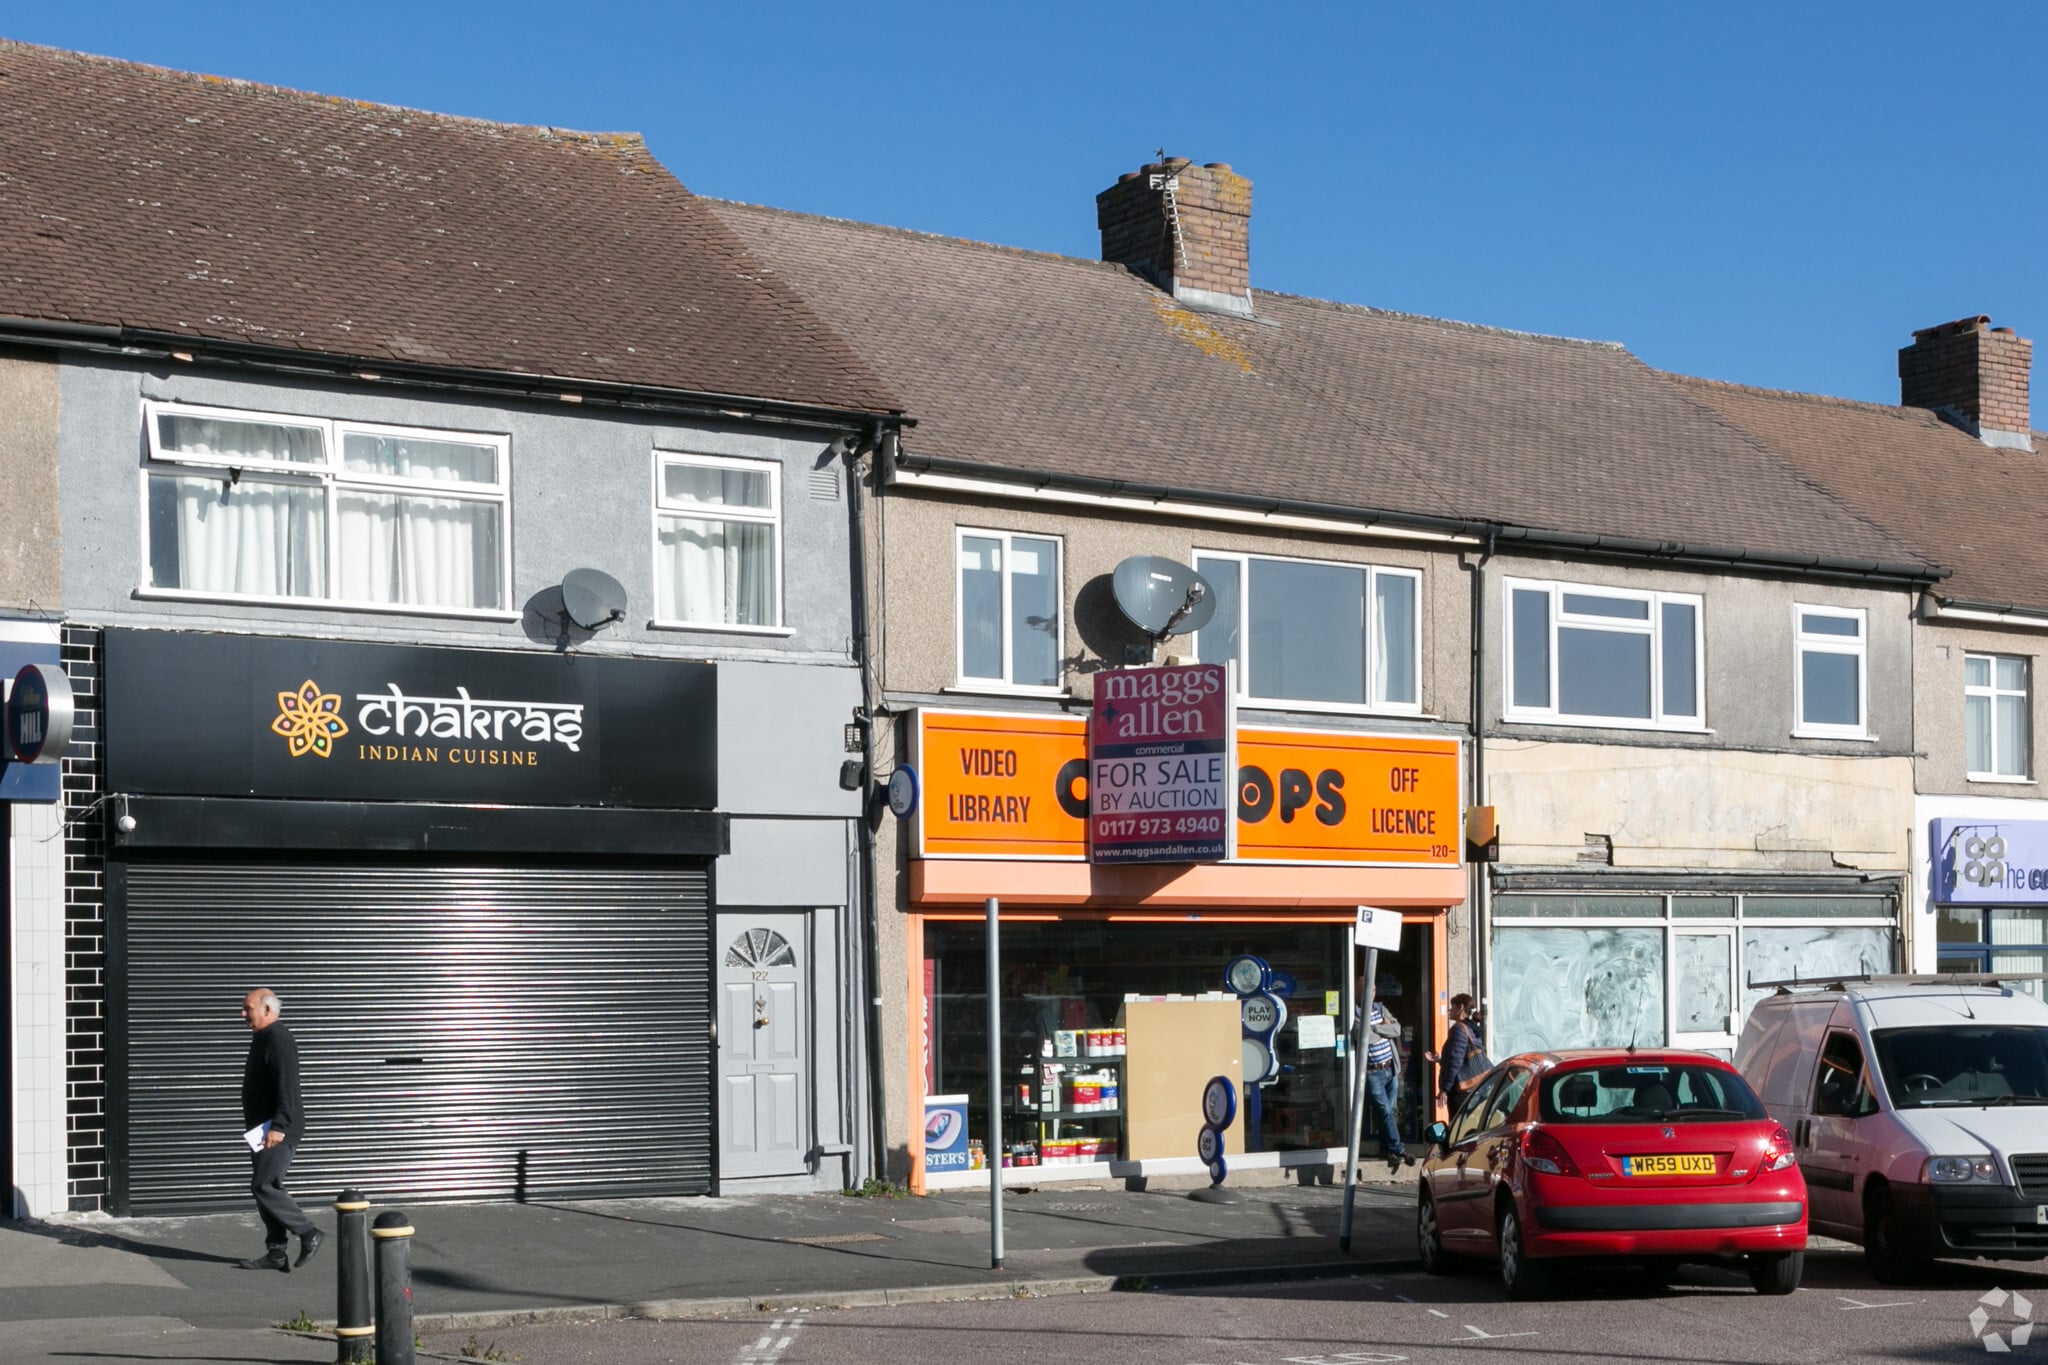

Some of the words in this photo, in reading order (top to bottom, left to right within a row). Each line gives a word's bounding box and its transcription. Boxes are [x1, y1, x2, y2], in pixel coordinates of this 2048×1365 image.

[1105, 669, 1219, 706] maggs
[357, 683, 584, 752] chakras
[1119, 701, 1205, 737] allen
[359, 745, 438, 762] INDIAN
[449, 748, 538, 766] CUISINE
[1135, 743, 1184, 756] commercial
[961, 748, 1017, 777] VIDEO
[1097, 762, 1147, 788] FOR
[1158, 758, 1221, 785] SALE
[1391, 767, 1419, 793] OFF
[948, 794, 1031, 823] LIBRARY
[1101, 793, 1123, 811] BY
[1128, 788, 1217, 810] AUCTION
[1100, 820, 1136, 837] 0117
[1139, 818, 1171, 835] 973
[1175, 816, 1220, 833] 4940
[1372, 808, 1435, 835] LICENCE
[1095, 844, 1224, 858] www.maggsandallen.co.uk
[1431, 845, 1448, 858] 120
[2000, 862, 2025, 890] he
[1363, 911, 1371, 922] P
[752, 970, 768, 981] 122
[1248, 1006, 1271, 1014] PLAY
[1249, 1014, 1271, 1022] NOW
[1634, 1157, 1676, 1171] WR59
[1681, 1156, 1712, 1171] UXD
